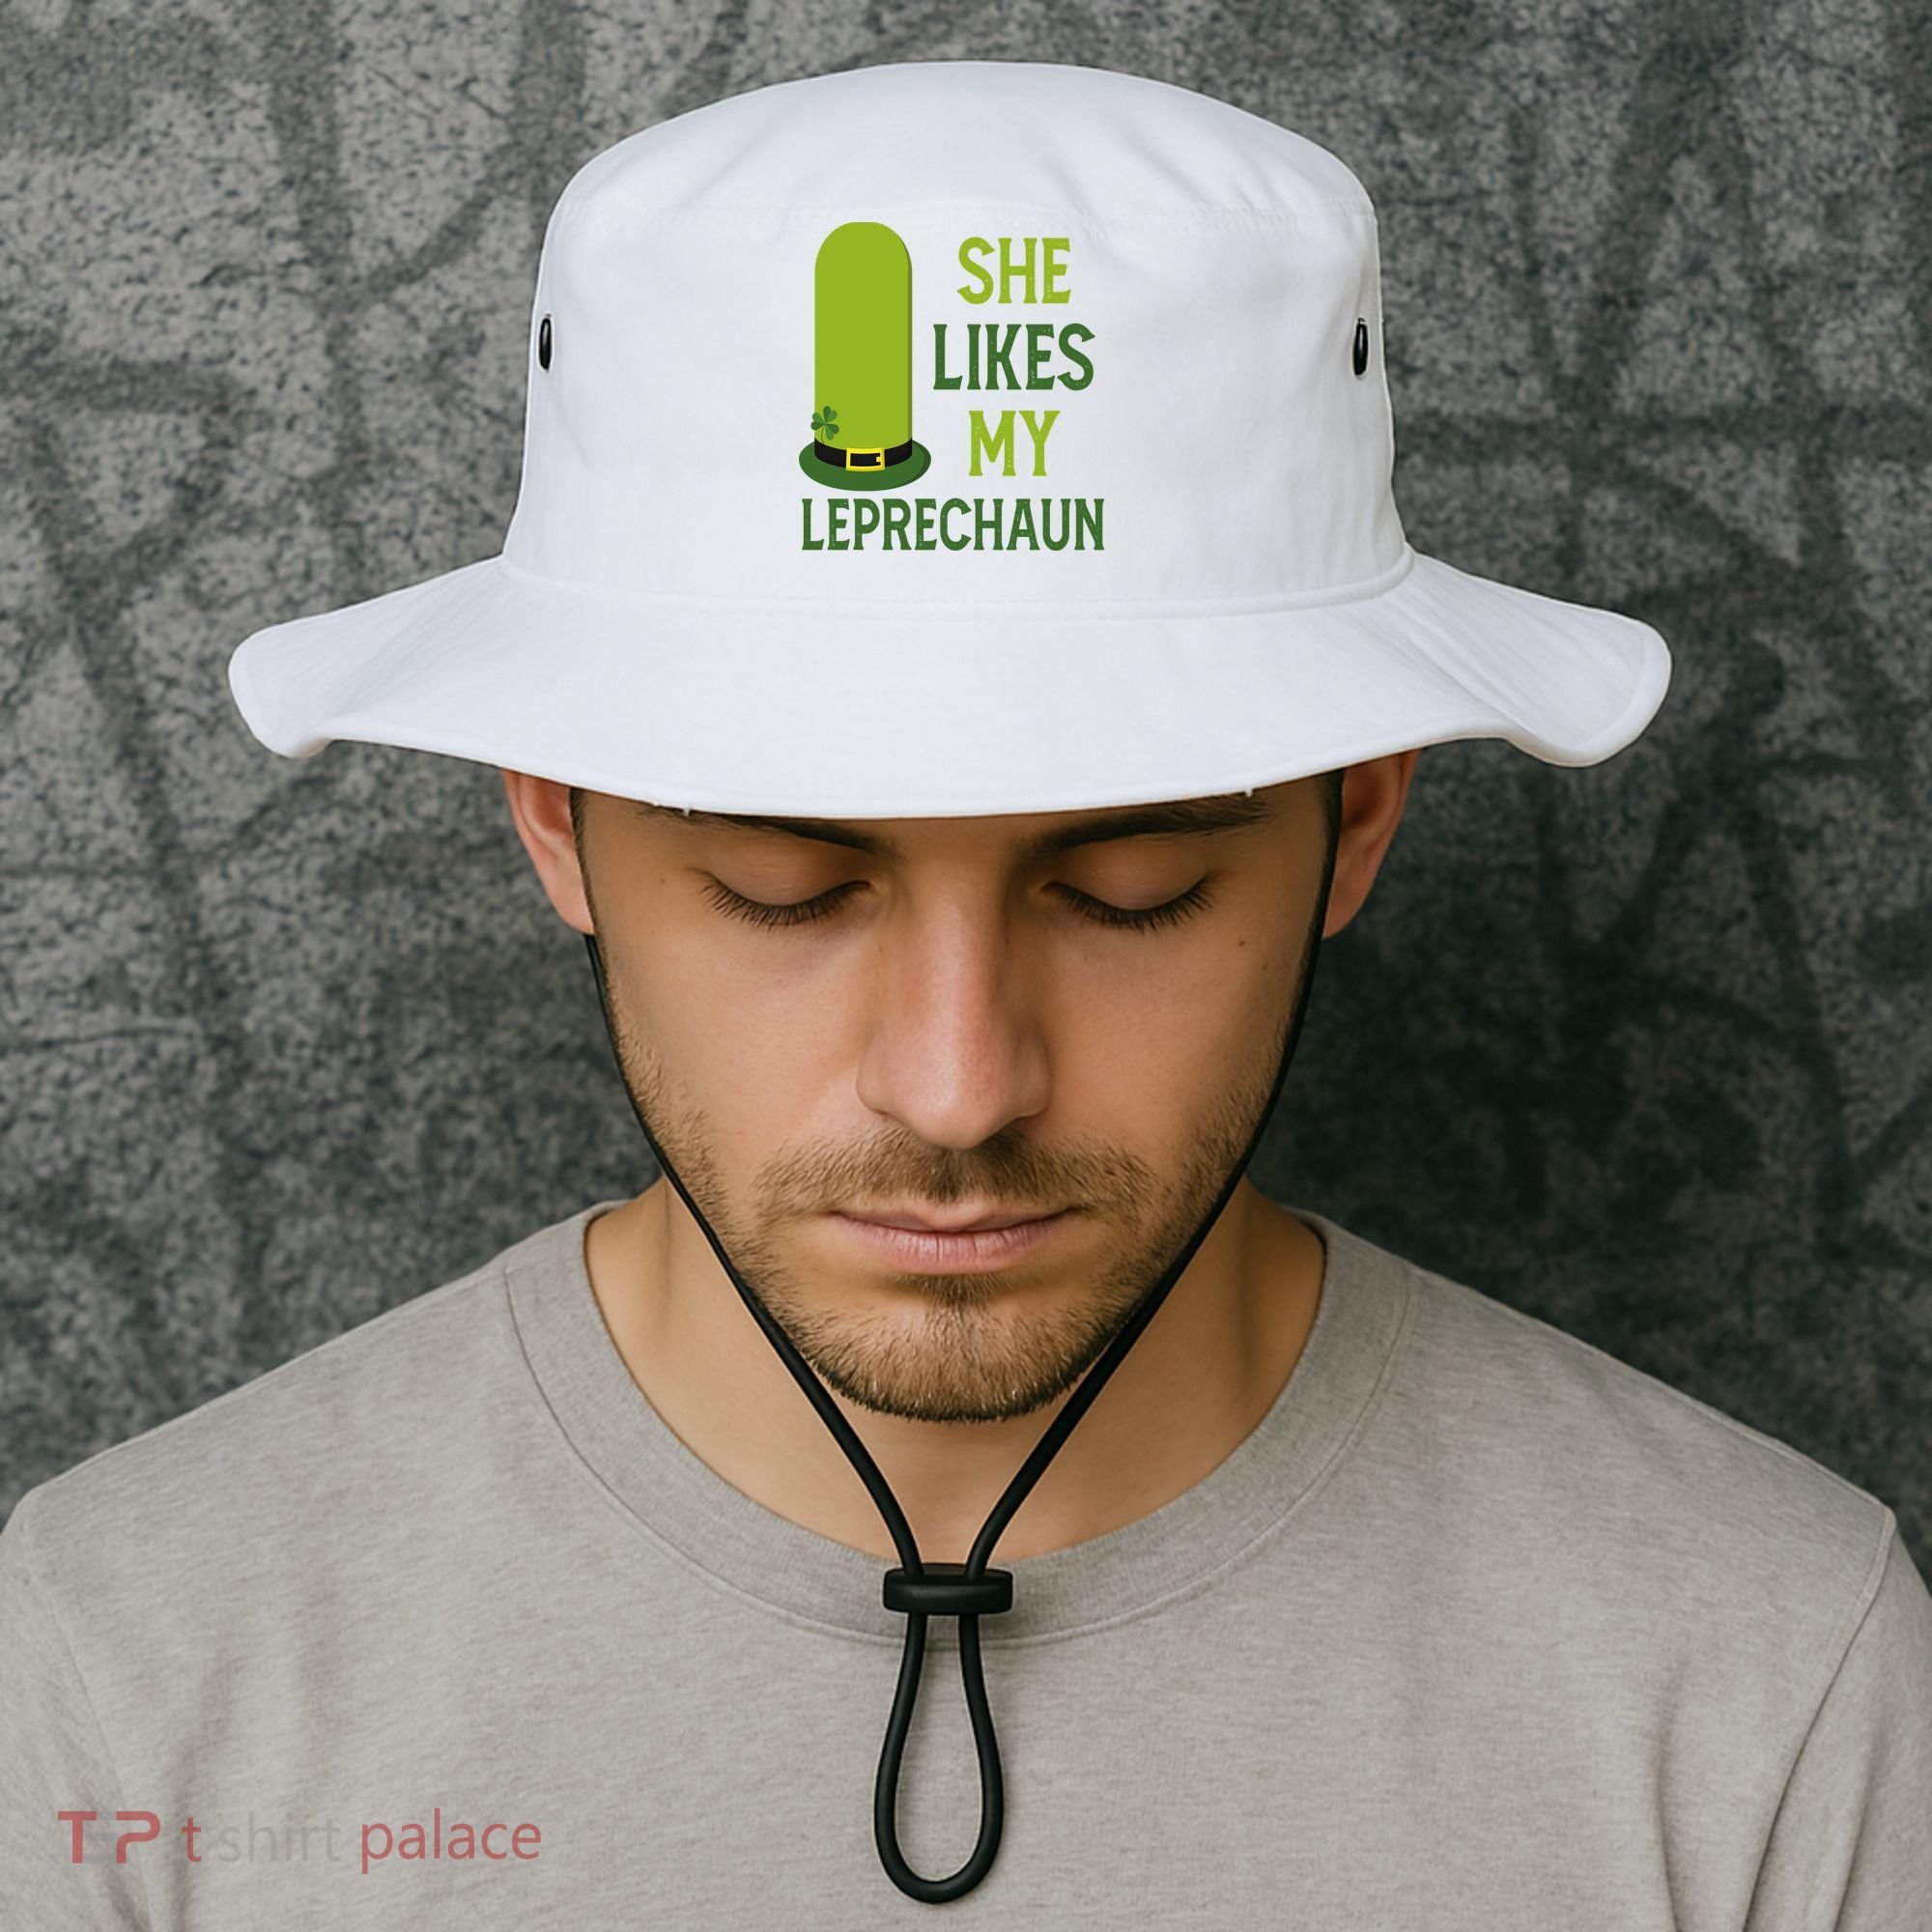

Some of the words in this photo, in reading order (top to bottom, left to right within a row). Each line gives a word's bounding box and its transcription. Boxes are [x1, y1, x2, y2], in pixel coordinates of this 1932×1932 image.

[957, 237, 1071, 304] SHE
[933, 323, 1095, 390] LIKES
[968, 410, 1061, 476] MY
[801, 497, 1105, 552] LEPRECHAUN
